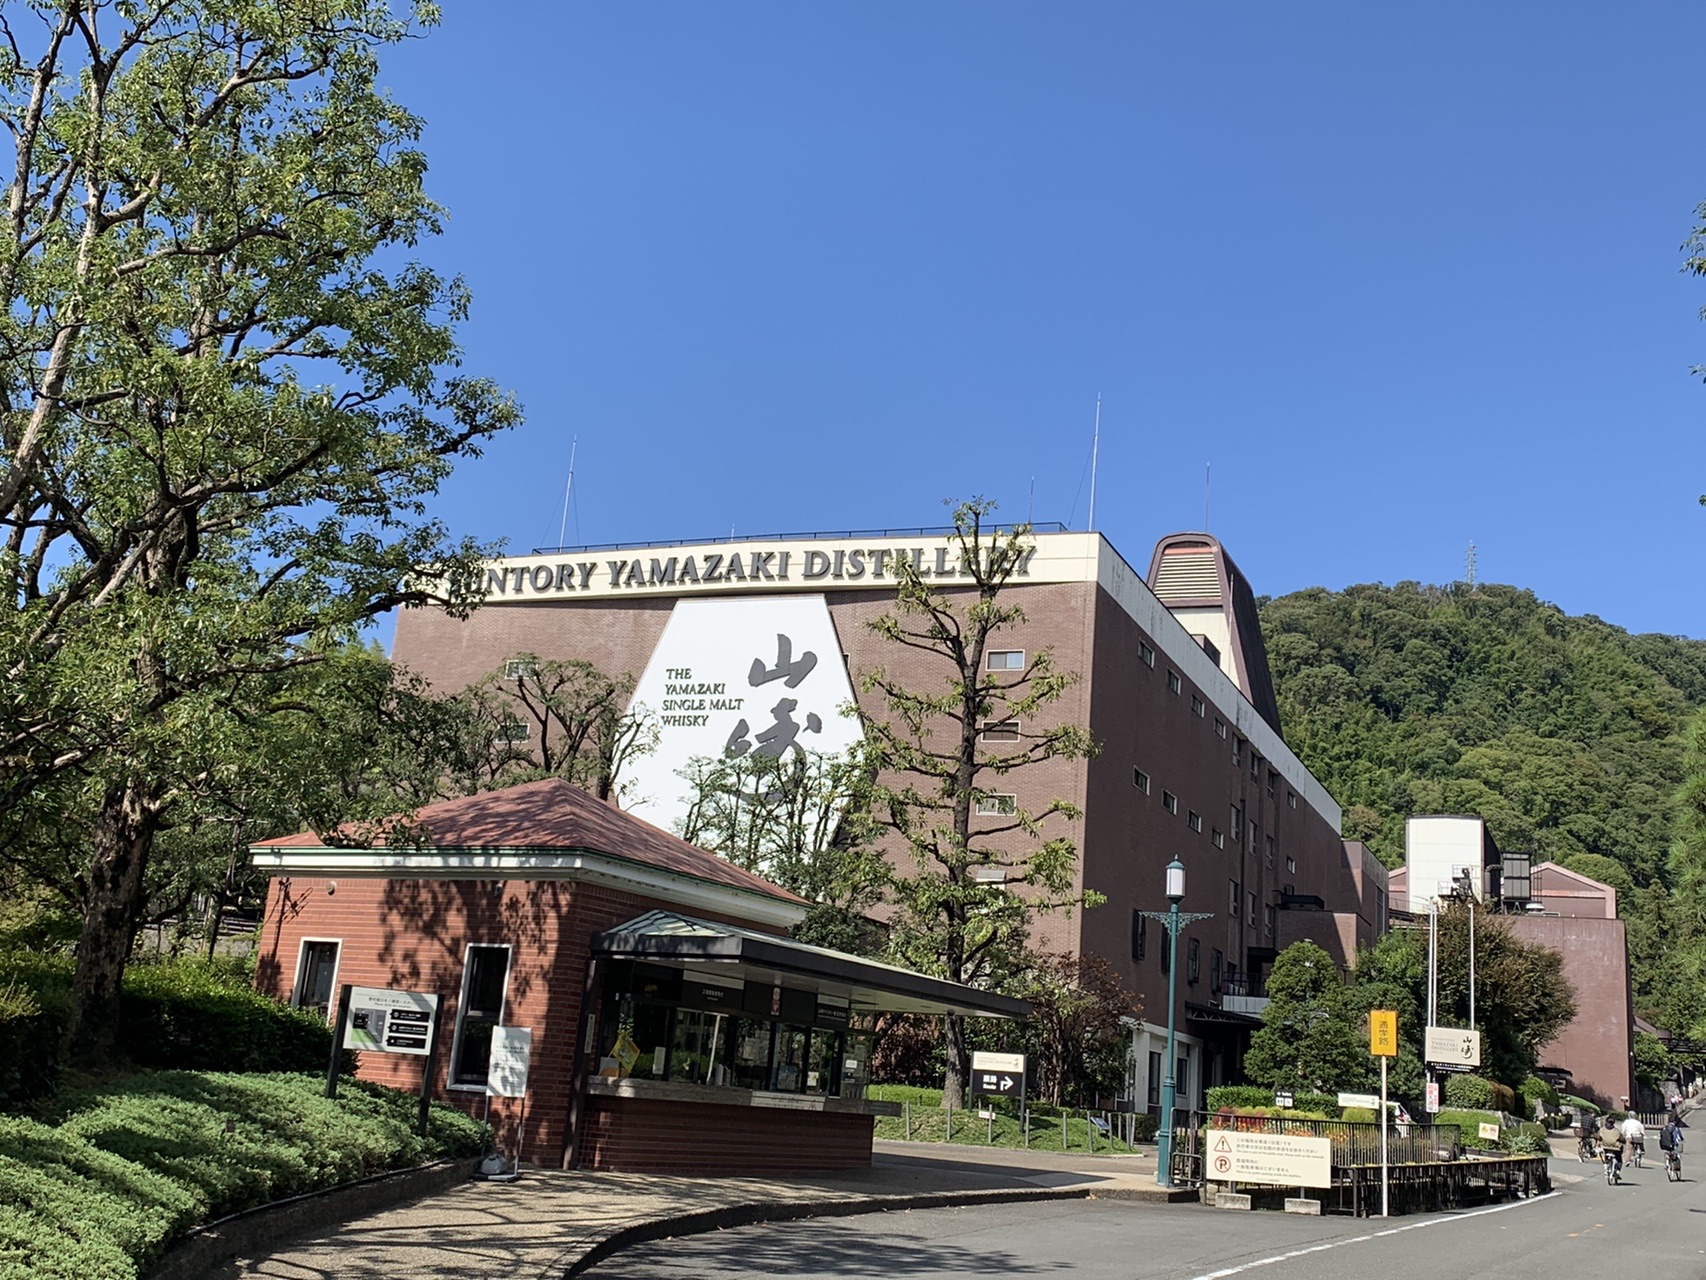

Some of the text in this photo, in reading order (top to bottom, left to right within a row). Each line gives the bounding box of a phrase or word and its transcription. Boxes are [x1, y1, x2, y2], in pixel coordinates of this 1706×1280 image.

[606, 550, 790, 587] YAMAZAKI
[666, 668, 692, 680] THE
[664, 683, 726, 696] YAMAZAKI
[661, 698, 745, 711] SINGLE MALT
[660, 714, 709, 727] WHISKY
[1379, 1020, 1389, 1046] 通学路
